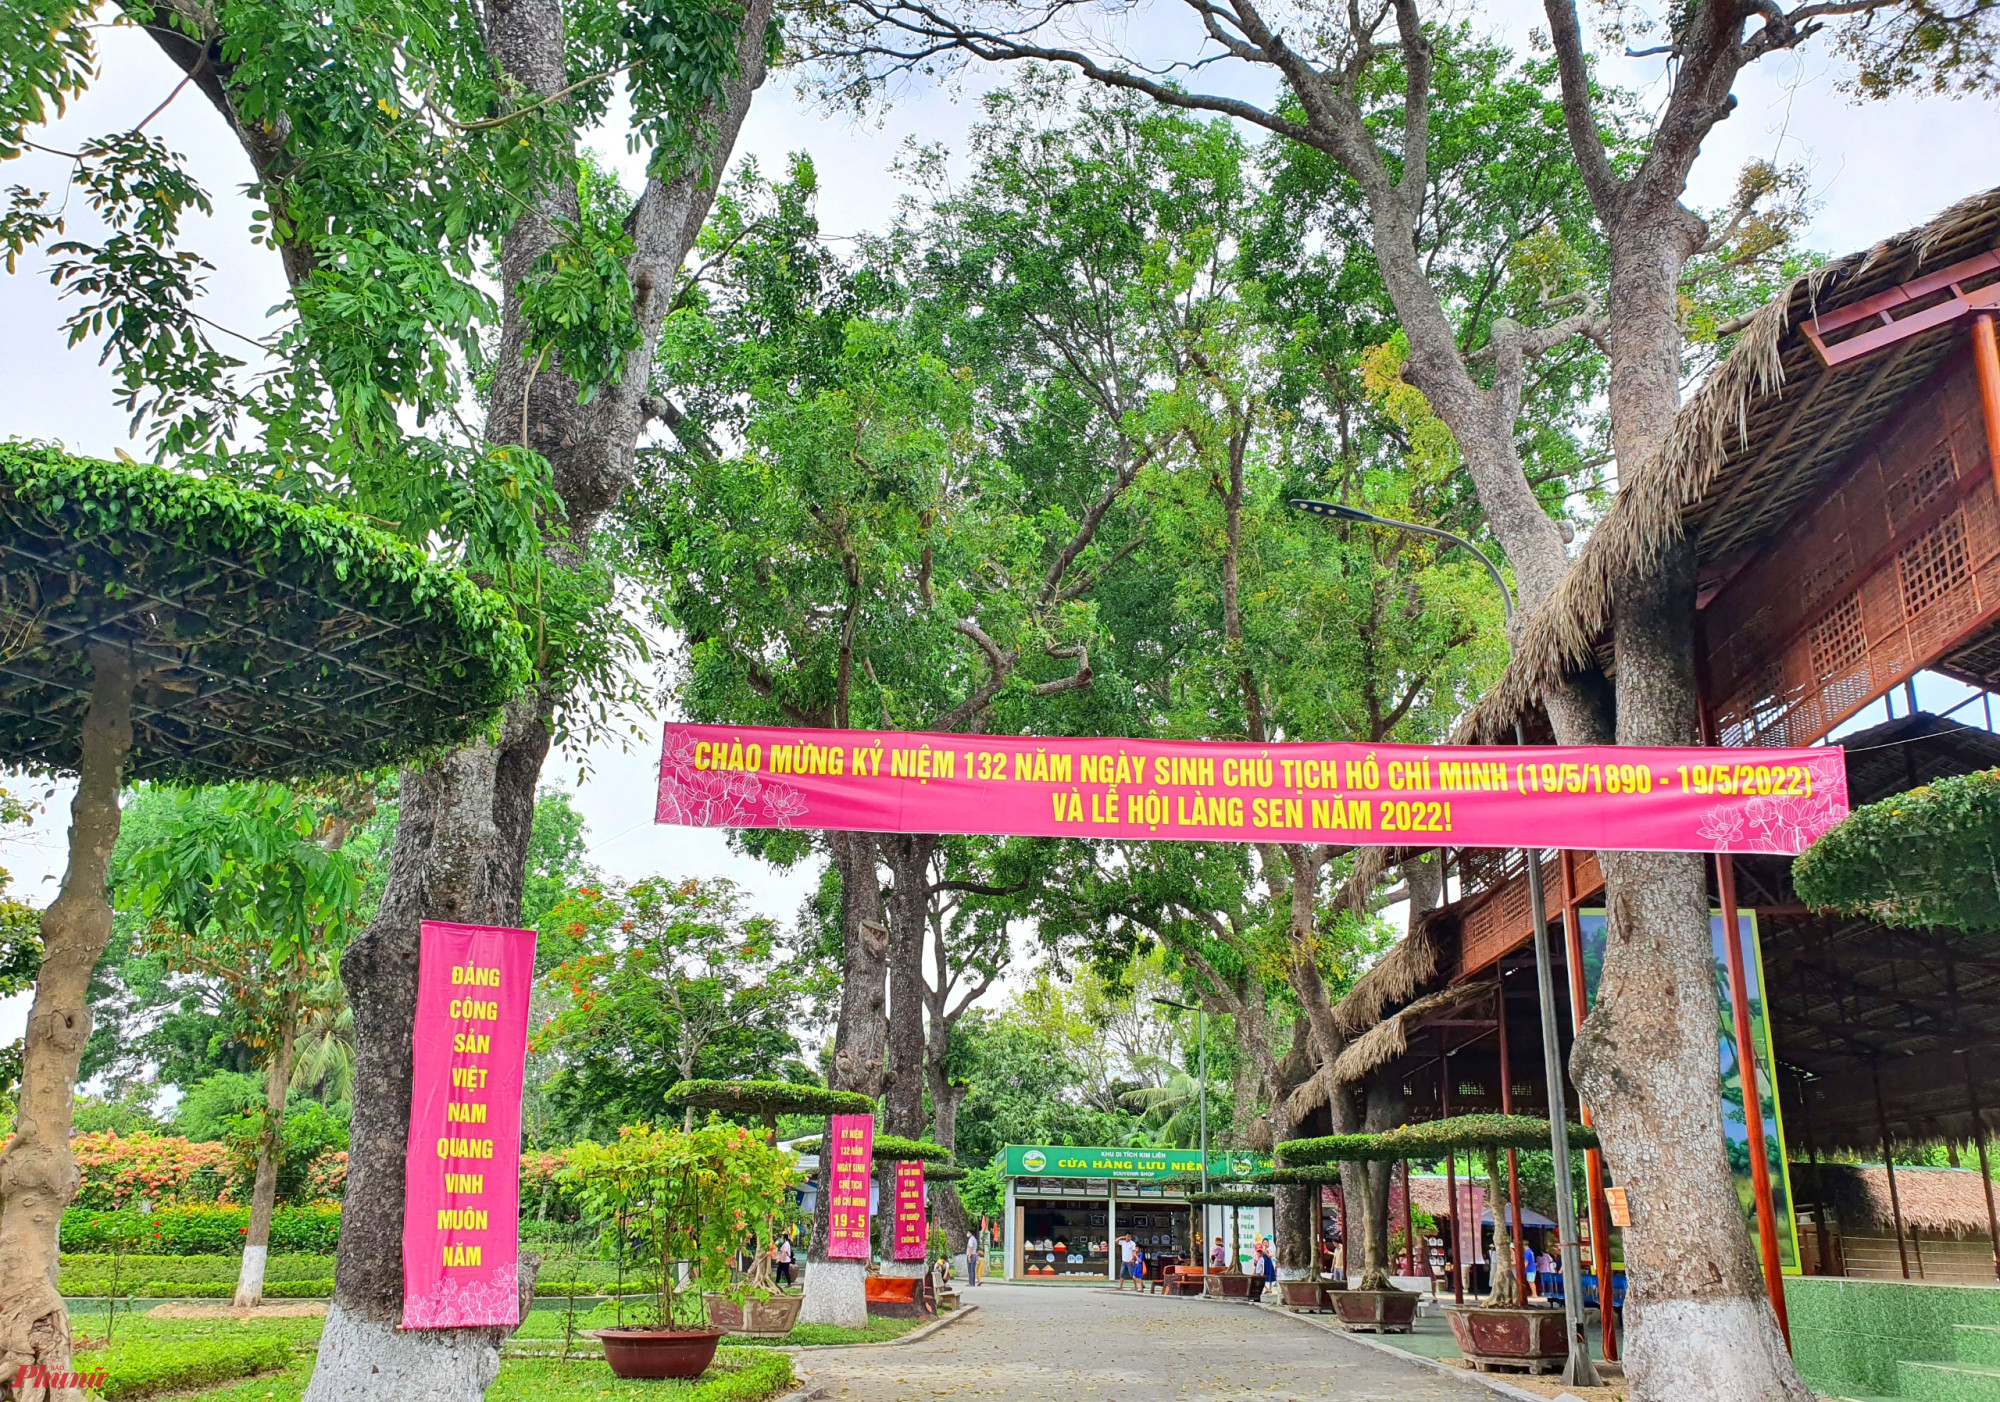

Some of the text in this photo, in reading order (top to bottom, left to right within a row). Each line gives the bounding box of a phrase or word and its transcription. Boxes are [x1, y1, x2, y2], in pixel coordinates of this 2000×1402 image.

[694, 736, 1814, 799] CHÀO MỪNG KỶ NIỆM 132 NĂM NGÀY SINH CHỦ TỊCH HỒ CHÍ MINH (19/5/1890 - 19/5/2022)
[1051, 783, 1452, 834] VÀ LỄ HỘI LÀNG SEN NĂM 2022!
[451, 961, 501, 988] ĐẢNG
[449, 996, 498, 1022] CỘNG
[453, 1028, 491, 1054] SẢN
[452, 1066, 488, 1093] VIỆT
[447, 1102, 487, 1124] NAM
[436, 1138, 494, 1160] QUANG
[840, 1146, 850, 1156] 132
[1058, 1158, 1088, 1168] CỬA
[1092, 1158, 1132, 1169] HÀNG
[1138, 1162, 1166, 1170] LƯU
[444, 1172, 484, 1194] VINH
[437, 1207, 488, 1231] MUÔN
[834, 1214, 848, 1227] 19
[858, 1214, 865, 1228] 5
[442, 1241, 482, 1267] NĂM
